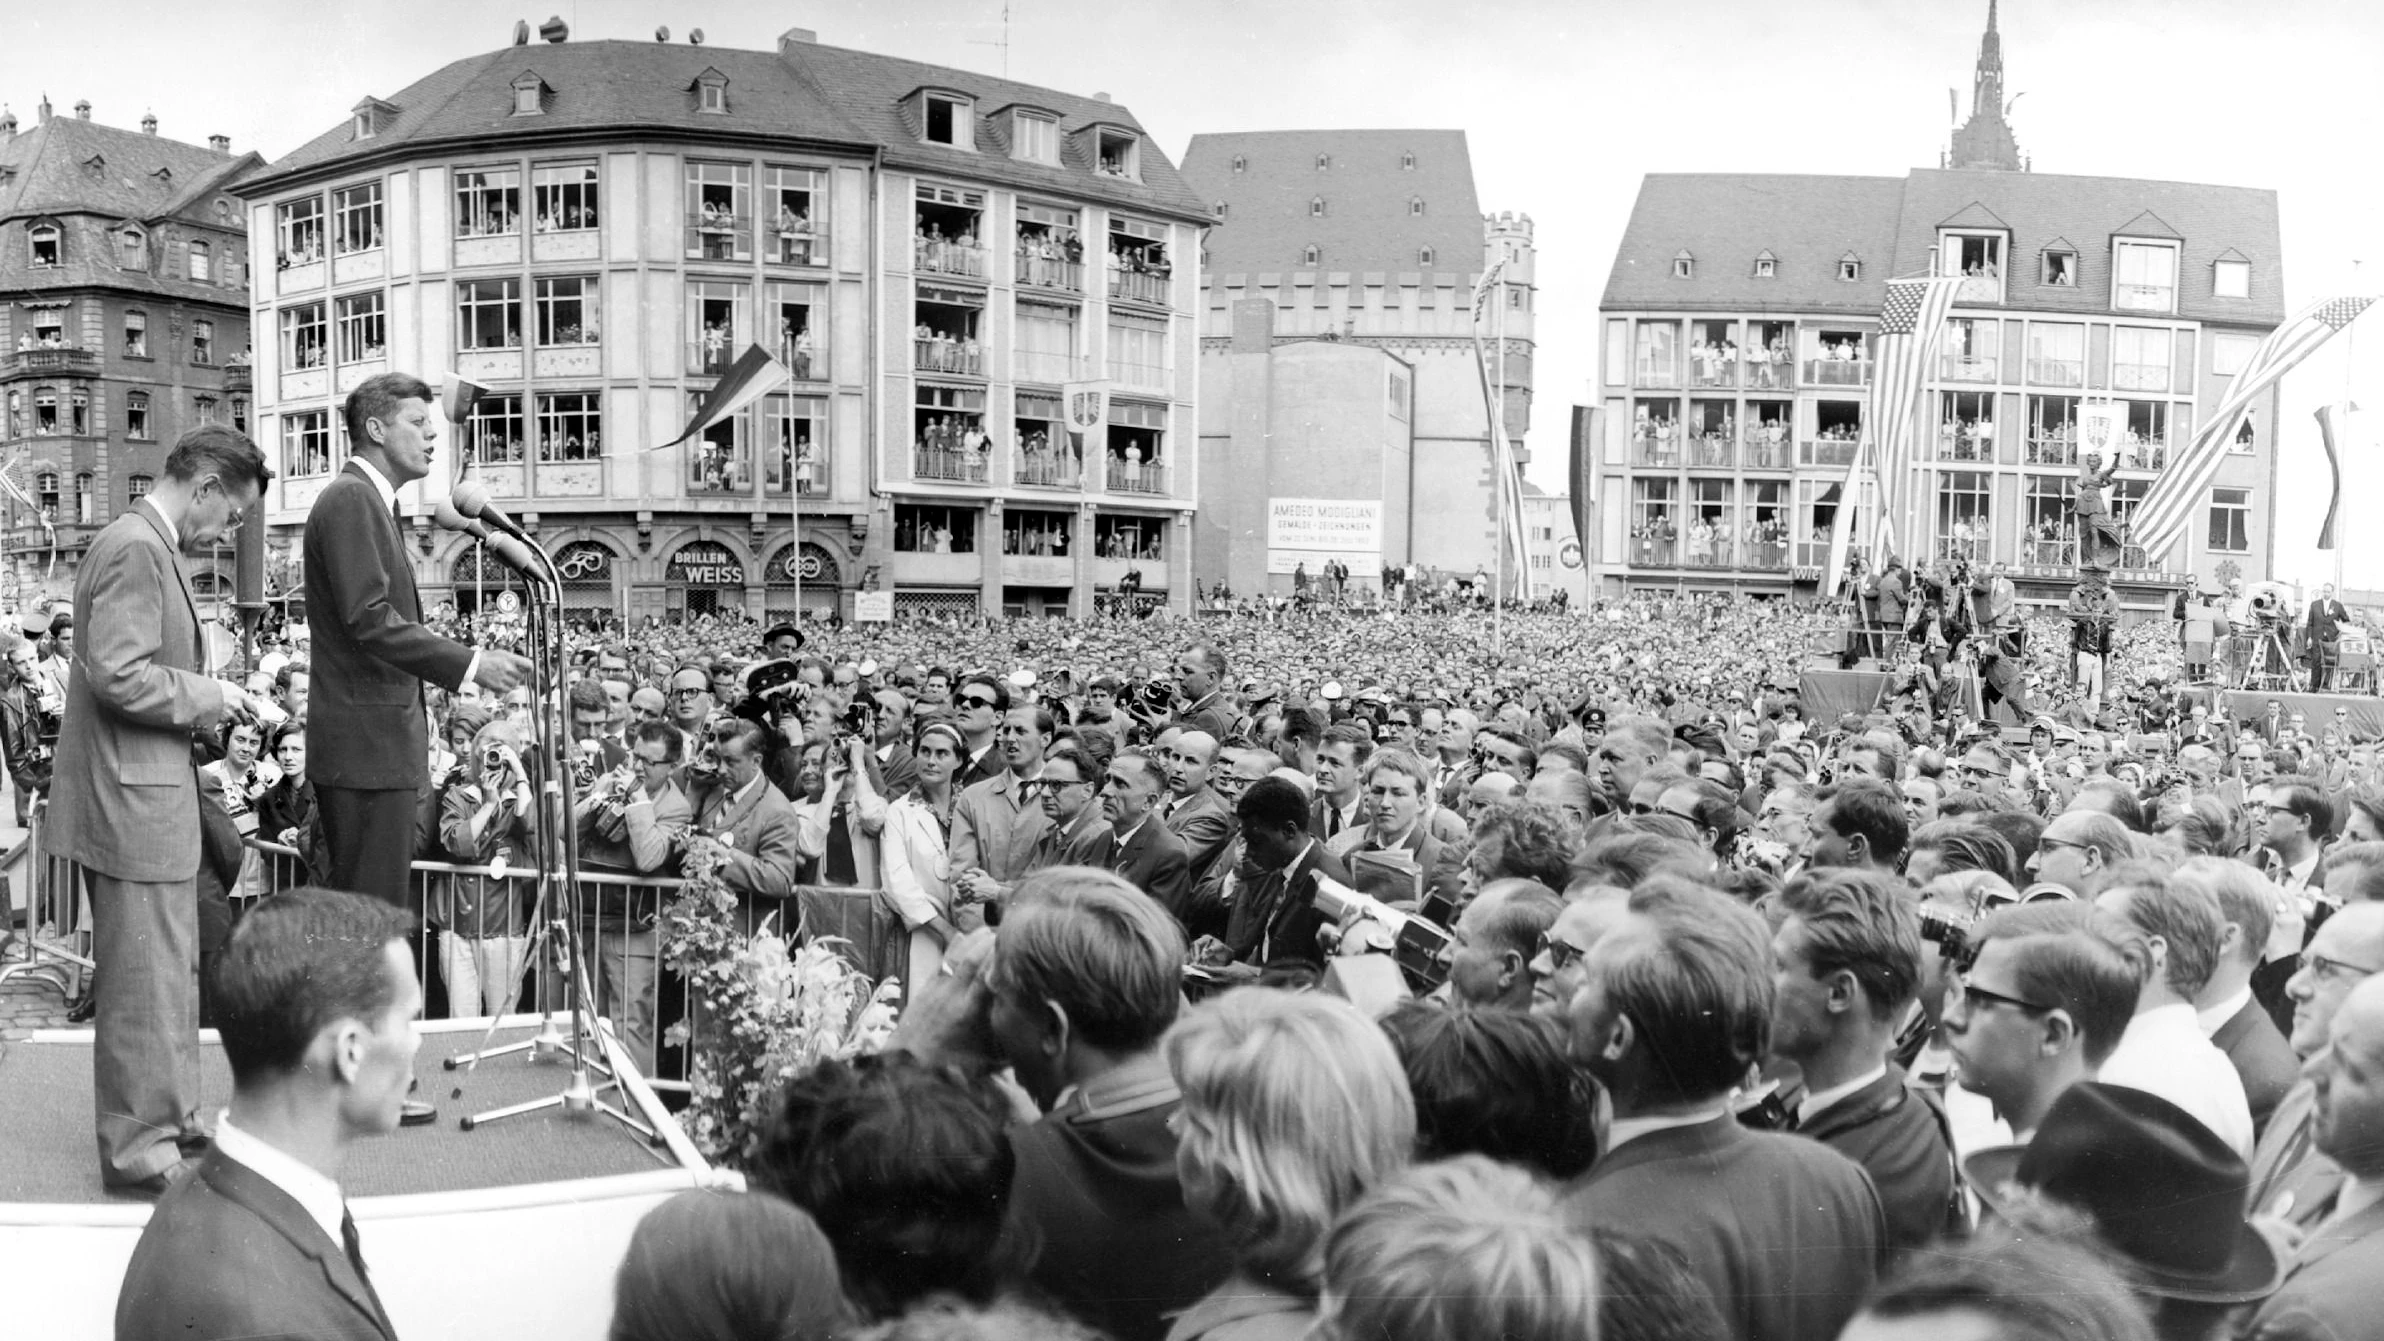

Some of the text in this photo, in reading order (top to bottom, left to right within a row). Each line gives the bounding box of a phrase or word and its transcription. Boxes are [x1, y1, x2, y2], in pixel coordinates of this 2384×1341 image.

[1273, 504, 1377, 518] AMEDEO MODIGLIANI
[675, 552, 727, 564] BRILLEN
[685, 566, 743, 583] WEISS
